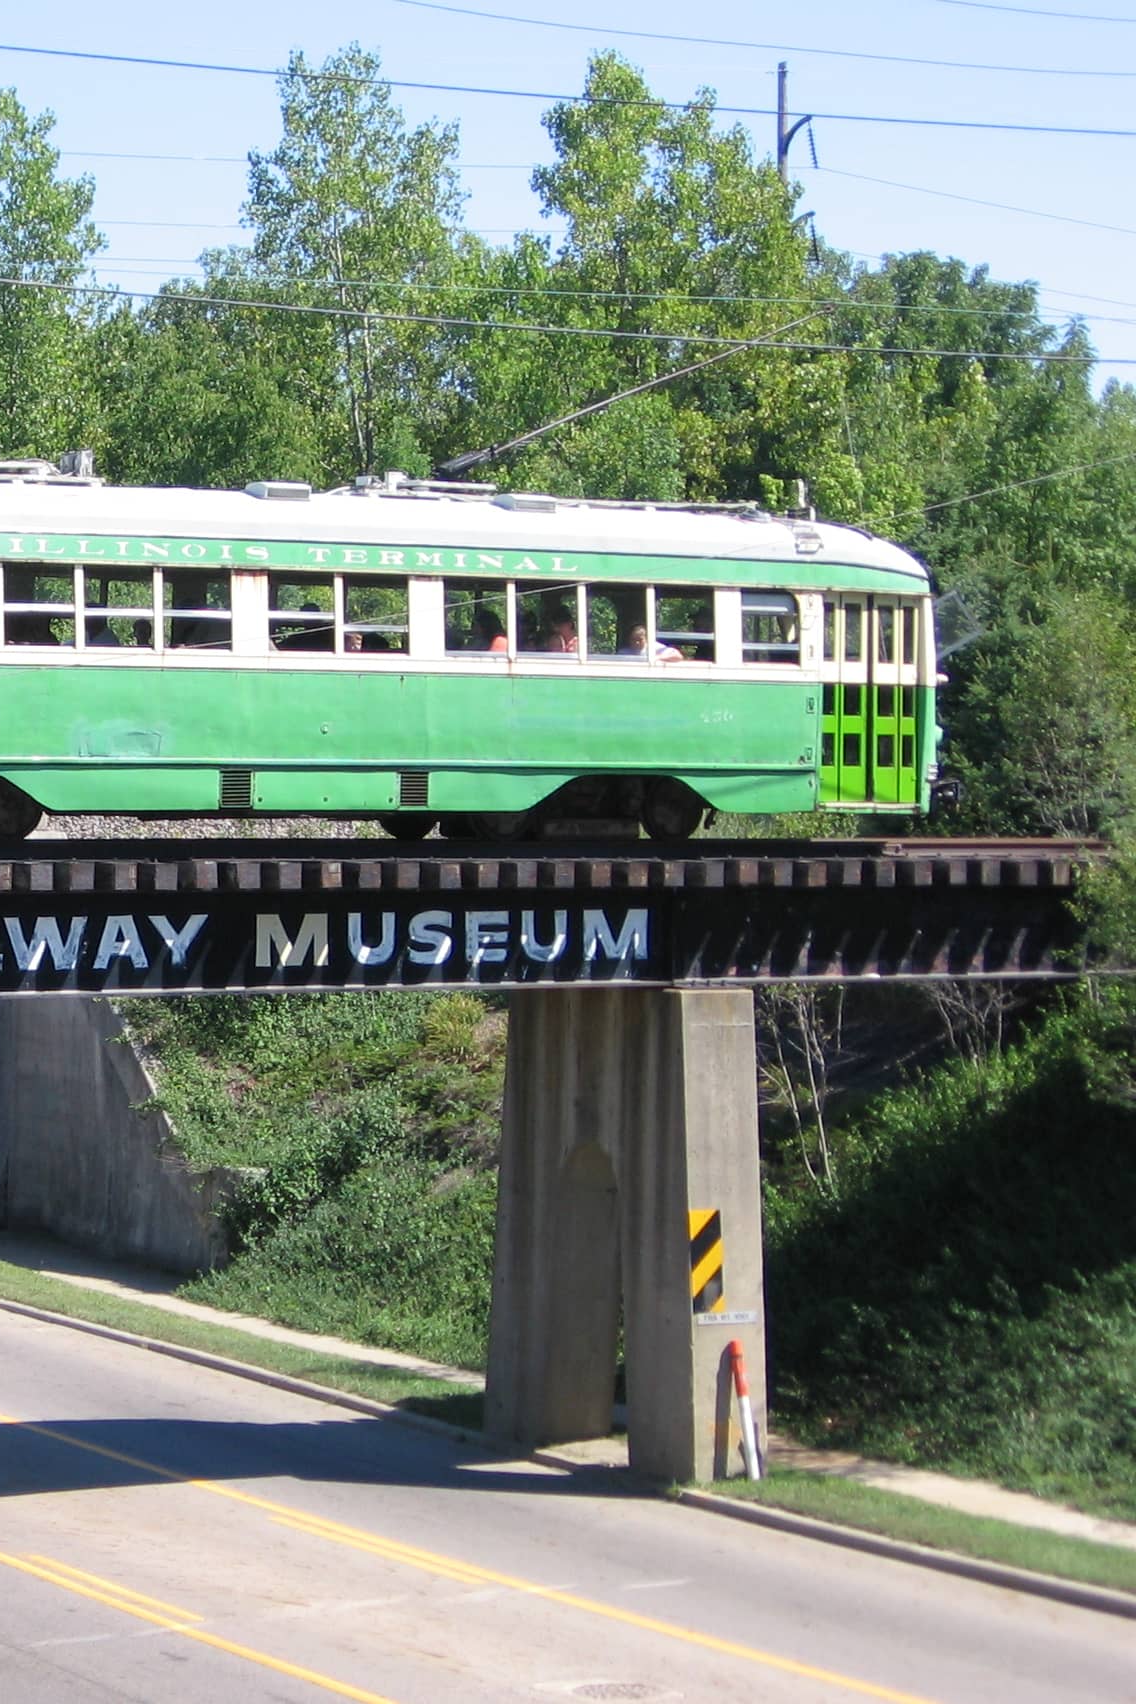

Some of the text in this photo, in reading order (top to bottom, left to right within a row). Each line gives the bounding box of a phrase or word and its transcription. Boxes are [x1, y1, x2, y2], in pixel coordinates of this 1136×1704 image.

[9, 537, 578, 573] ILLINOIS TERMINAL
[255, 908, 648, 967] MUSEUM
